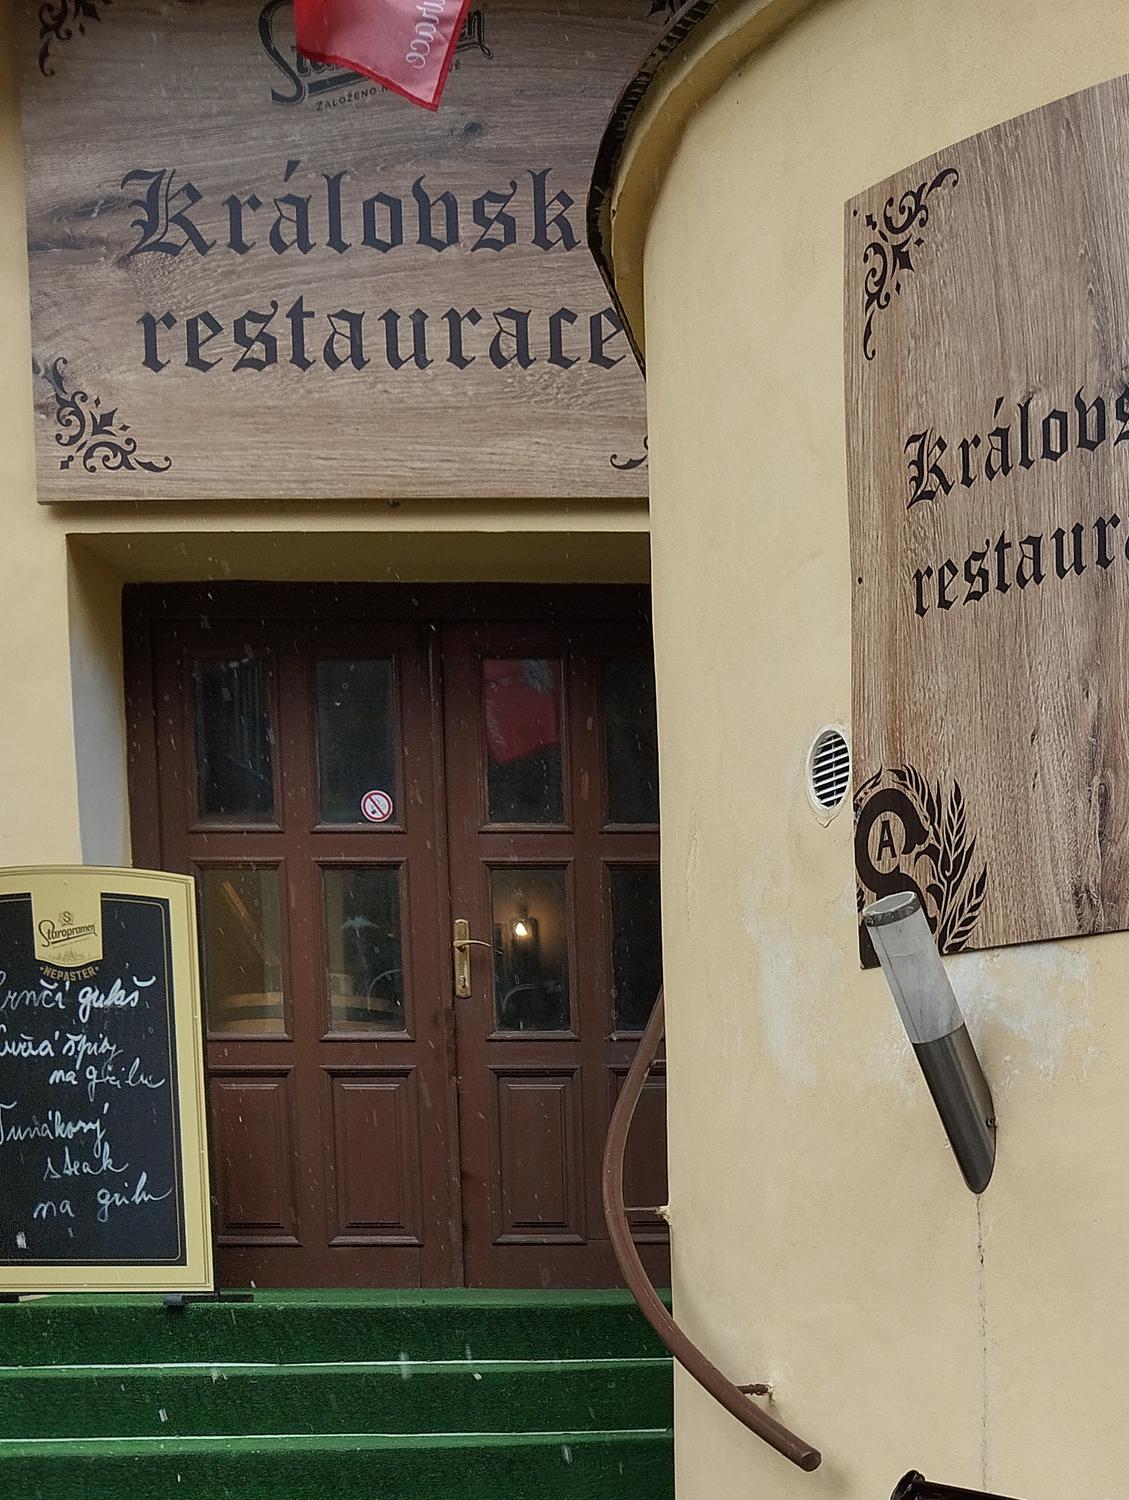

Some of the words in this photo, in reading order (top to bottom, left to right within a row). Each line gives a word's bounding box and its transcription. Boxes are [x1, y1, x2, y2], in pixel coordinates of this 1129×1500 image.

[316, 86, 377, 111] ZALOŽENO
[121, 160, 582, 258] Královsk
[137, 295, 627, 372] restaurace
[38, 920, 98, 947] Staropramen
[50, 1068, 78, 1085] na
[43, 1142, 129, 1181] steak
[33, 1200, 75, 1219] na
